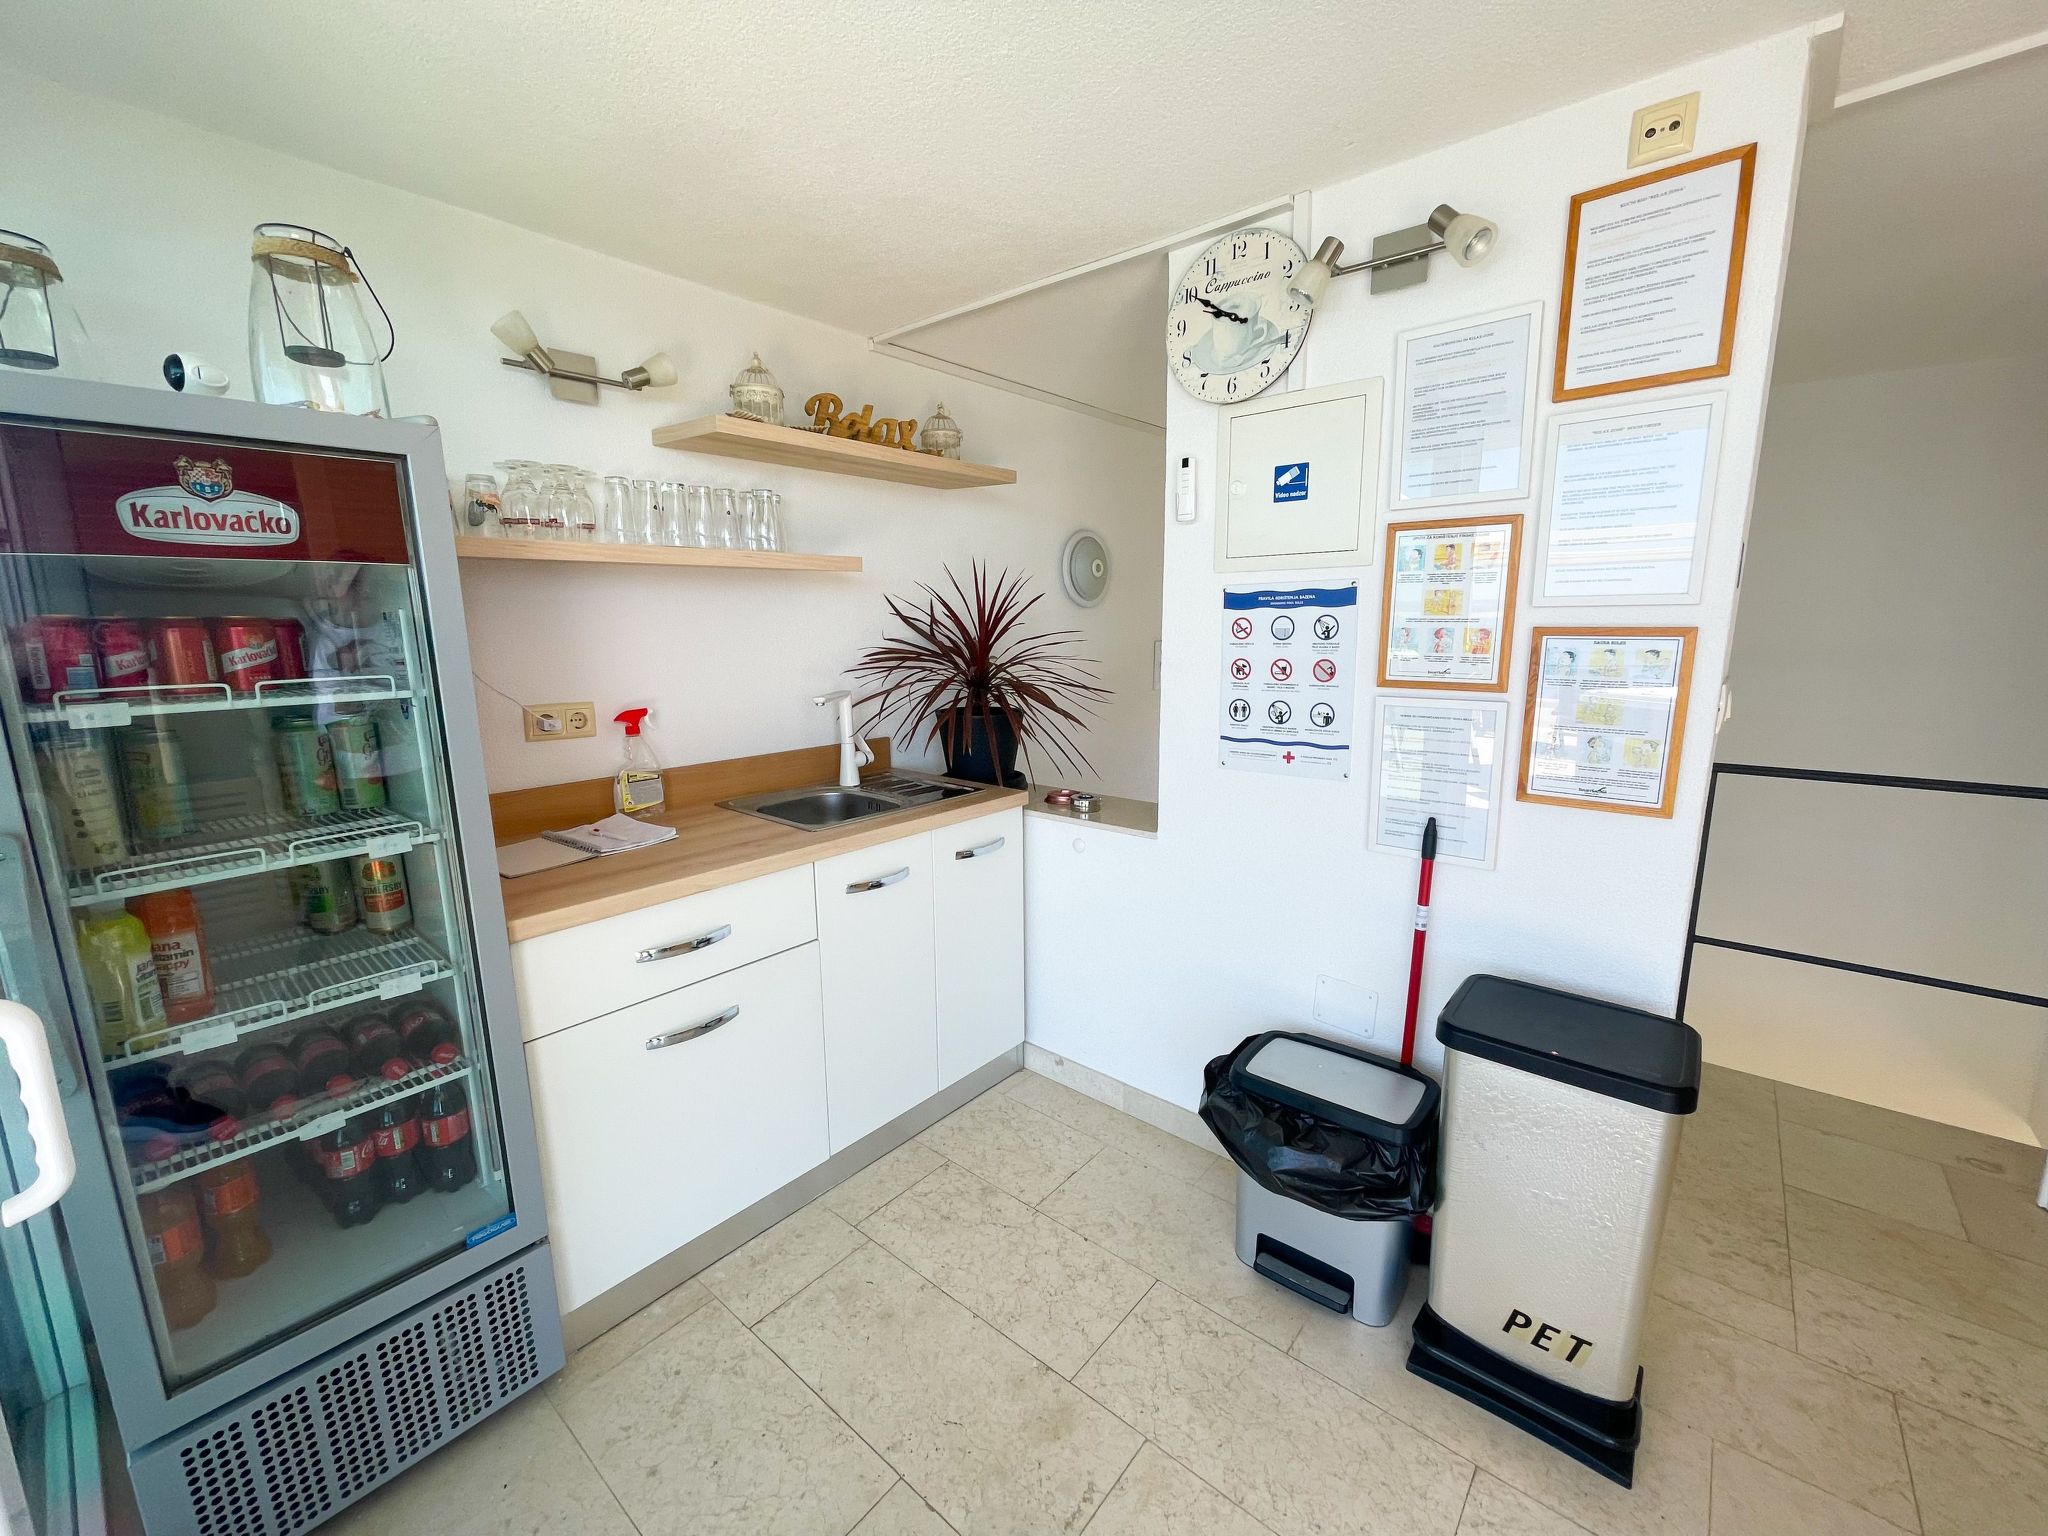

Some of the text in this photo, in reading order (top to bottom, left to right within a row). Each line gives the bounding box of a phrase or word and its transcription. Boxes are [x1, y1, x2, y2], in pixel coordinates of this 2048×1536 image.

[1232, 240, 1247, 260] 12
[1264, 242, 1270, 259] 1
[1205, 258, 1216, 276] 11
[1282, 260, 1293, 279] 2
[1205, 271, 1271, 295] Cappuccino
[1184, 286, 1198, 305] 10
[1177, 319, 1187, 338] 9
[1281, 329, 1291, 349] 4
[1181, 351, 1192, 369] 8
[1260, 359, 1270, 378] 5
[1200, 373, 1209, 390] 7
[1227, 377, 1237, 394] 6
[804, 393, 918, 452] Relax
[129, 501, 292, 535] Karlovačko
[151, 941, 181, 952] ana
[1502, 1308, 1593, 1363] PET
